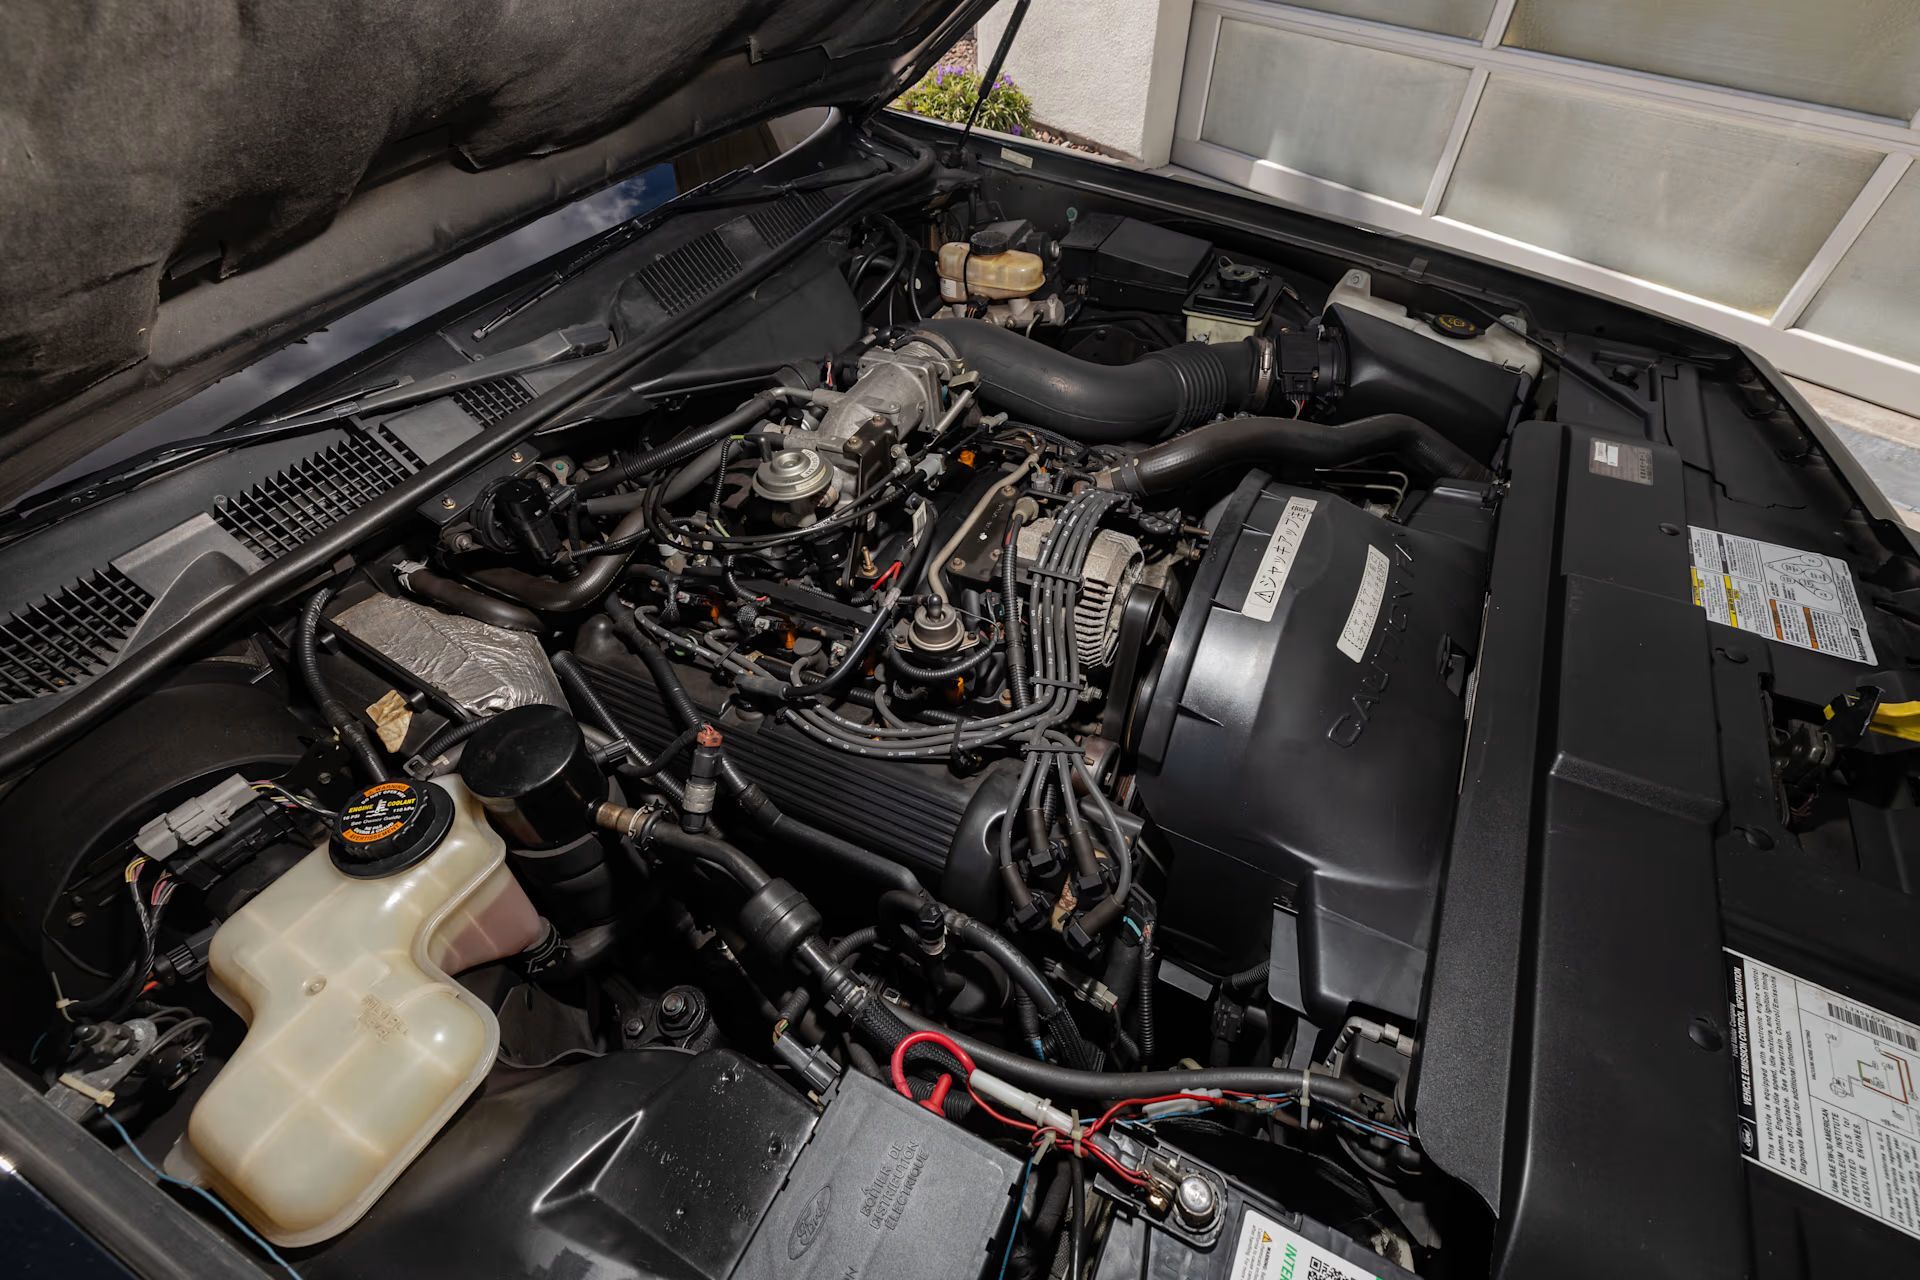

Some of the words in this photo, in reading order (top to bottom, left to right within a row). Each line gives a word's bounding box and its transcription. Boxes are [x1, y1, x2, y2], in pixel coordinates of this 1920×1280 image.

[348, 804, 374, 814] ENGINE
[387, 798, 416, 807] COOLANT
[1734, 966, 1744, 1009] INFORMATION
[1761, 972, 1769, 990] timing
[1754, 992, 1762, 1014] engine
[1763, 991, 1771, 1014] ignition
[1770, 976, 1782, 1035] Control/Emissions
[1737, 1008, 1746, 1041] CONTROL
[1756, 1016, 1765, 1048] electronic
[1740, 1041, 1749, 1074] EMISSION
[1767, 1029, 1775, 1054] mixture,
[1777, 1038, 1786, 1075] Powertrain
[1786, 1030, 1794, 1066] information.
[1742, 1075, 1752, 1105] VEHICLE
[1761, 1068, 1771, 1100] equipped
[1771, 1068, 1779, 1090] speed,
[1790, 1067, 1798, 1100] additional
[1765, 1113, 1773, 1140] vehicle
[1774, 1106, 1782, 1130] Engine
[1783, 1096, 1793, 1137] adjustable.
[1822, 1108, 1832, 1141] AMERICAN
[1832, 1112, 1842, 1148] INSTITUTE
[1842, 1117, 1850, 1128] for
[888, 1143, 904, 1160] DE
[1742, 1128, 1751, 1147] Ford
[1777, 1134, 1786, 1166] systems.
[1845, 1134, 1853, 1152] OILS
[1854, 1124, 1864, 1158] ENGINES
[1798, 1139, 1808, 1175] Diagnosis
[869, 1140, 919, 1230] DISTRIBUTION
[1837, 1152, 1848, 1197] PETROLEUM
[1848, 1158, 1860, 1202] CERTIFIED
[1860, 1165, 1871, 1208] GASOLINE
[796, 1200, 827, 1246] Ford
